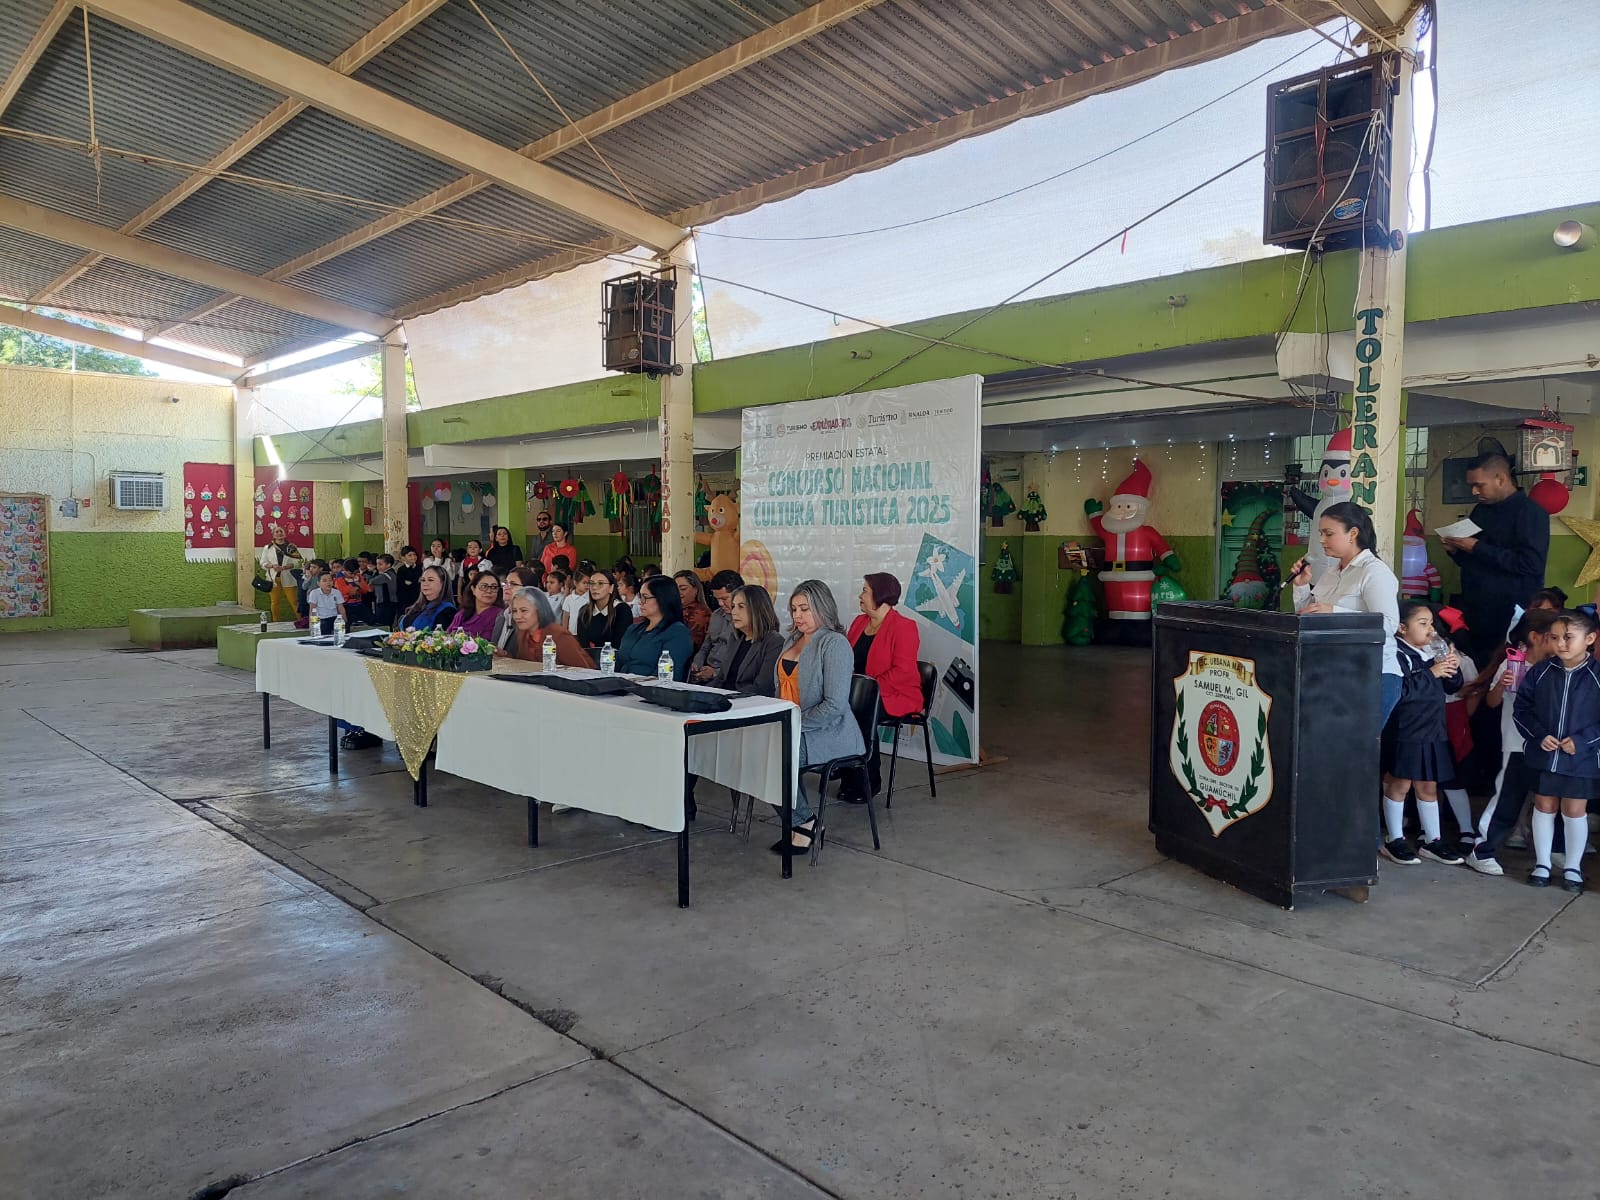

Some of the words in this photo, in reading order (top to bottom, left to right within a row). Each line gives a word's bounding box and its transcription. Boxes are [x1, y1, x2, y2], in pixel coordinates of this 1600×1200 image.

[868, 413, 898, 424] Turismo
[1350, 308, 1384, 516] TOLERAN
[856, 447, 888, 458] ESTATAL
[768, 467, 845, 497] CONCURSO
[852, 461, 933, 492] NACIONAL
[754, 500, 815, 527] CULTURA
[907, 494, 951, 525] 2025
[1210, 657, 1231, 668] URBANA
[1194, 679, 1222, 693] SAMUEL
[1225, 685, 1234, 696] M.
[1236, 687, 1249, 699] GIL
